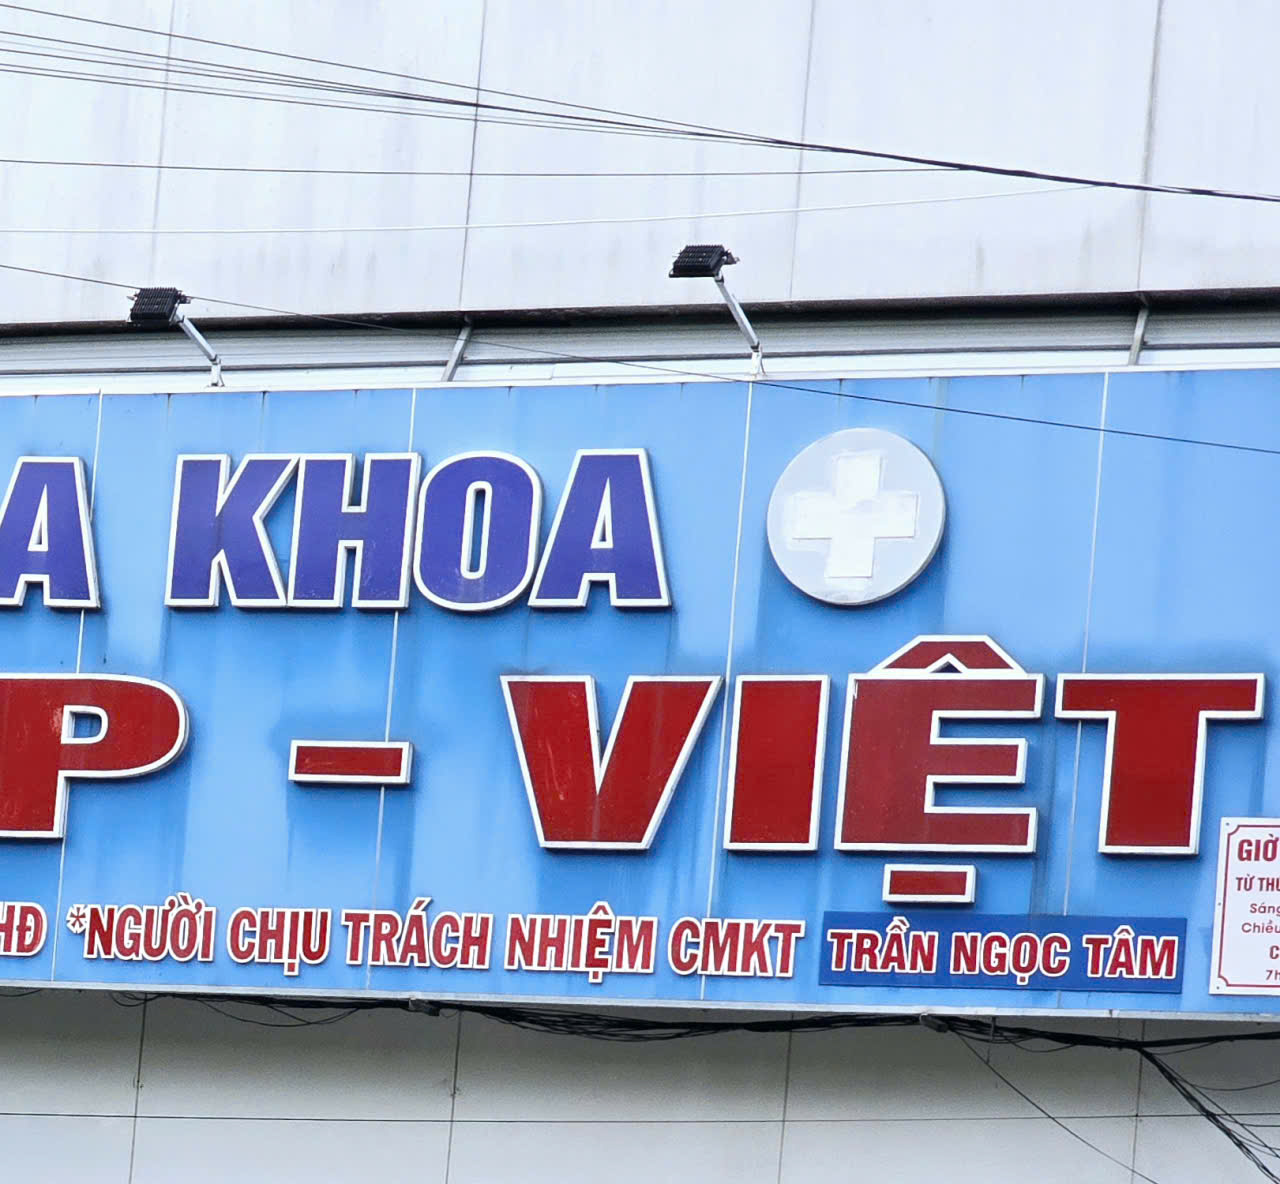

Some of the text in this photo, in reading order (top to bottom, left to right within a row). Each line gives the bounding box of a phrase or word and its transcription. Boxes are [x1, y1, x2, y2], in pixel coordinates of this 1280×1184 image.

[164, 448, 672, 612] KHOA
[288, 740, 413, 786] -
[500, 635, 1264, 904] VIỆT
[227, 907, 330, 976] CHỊU
[343, 897, 493, 970] TRÁCH
[504, 901, 655, 983] NHIỆM
[670, 917, 805, 978] CMKT
[827, 915, 936, 976] TRẦN
[950, 932, 1071, 985] NGỌC
[1083, 925, 1177, 980] TÂM
